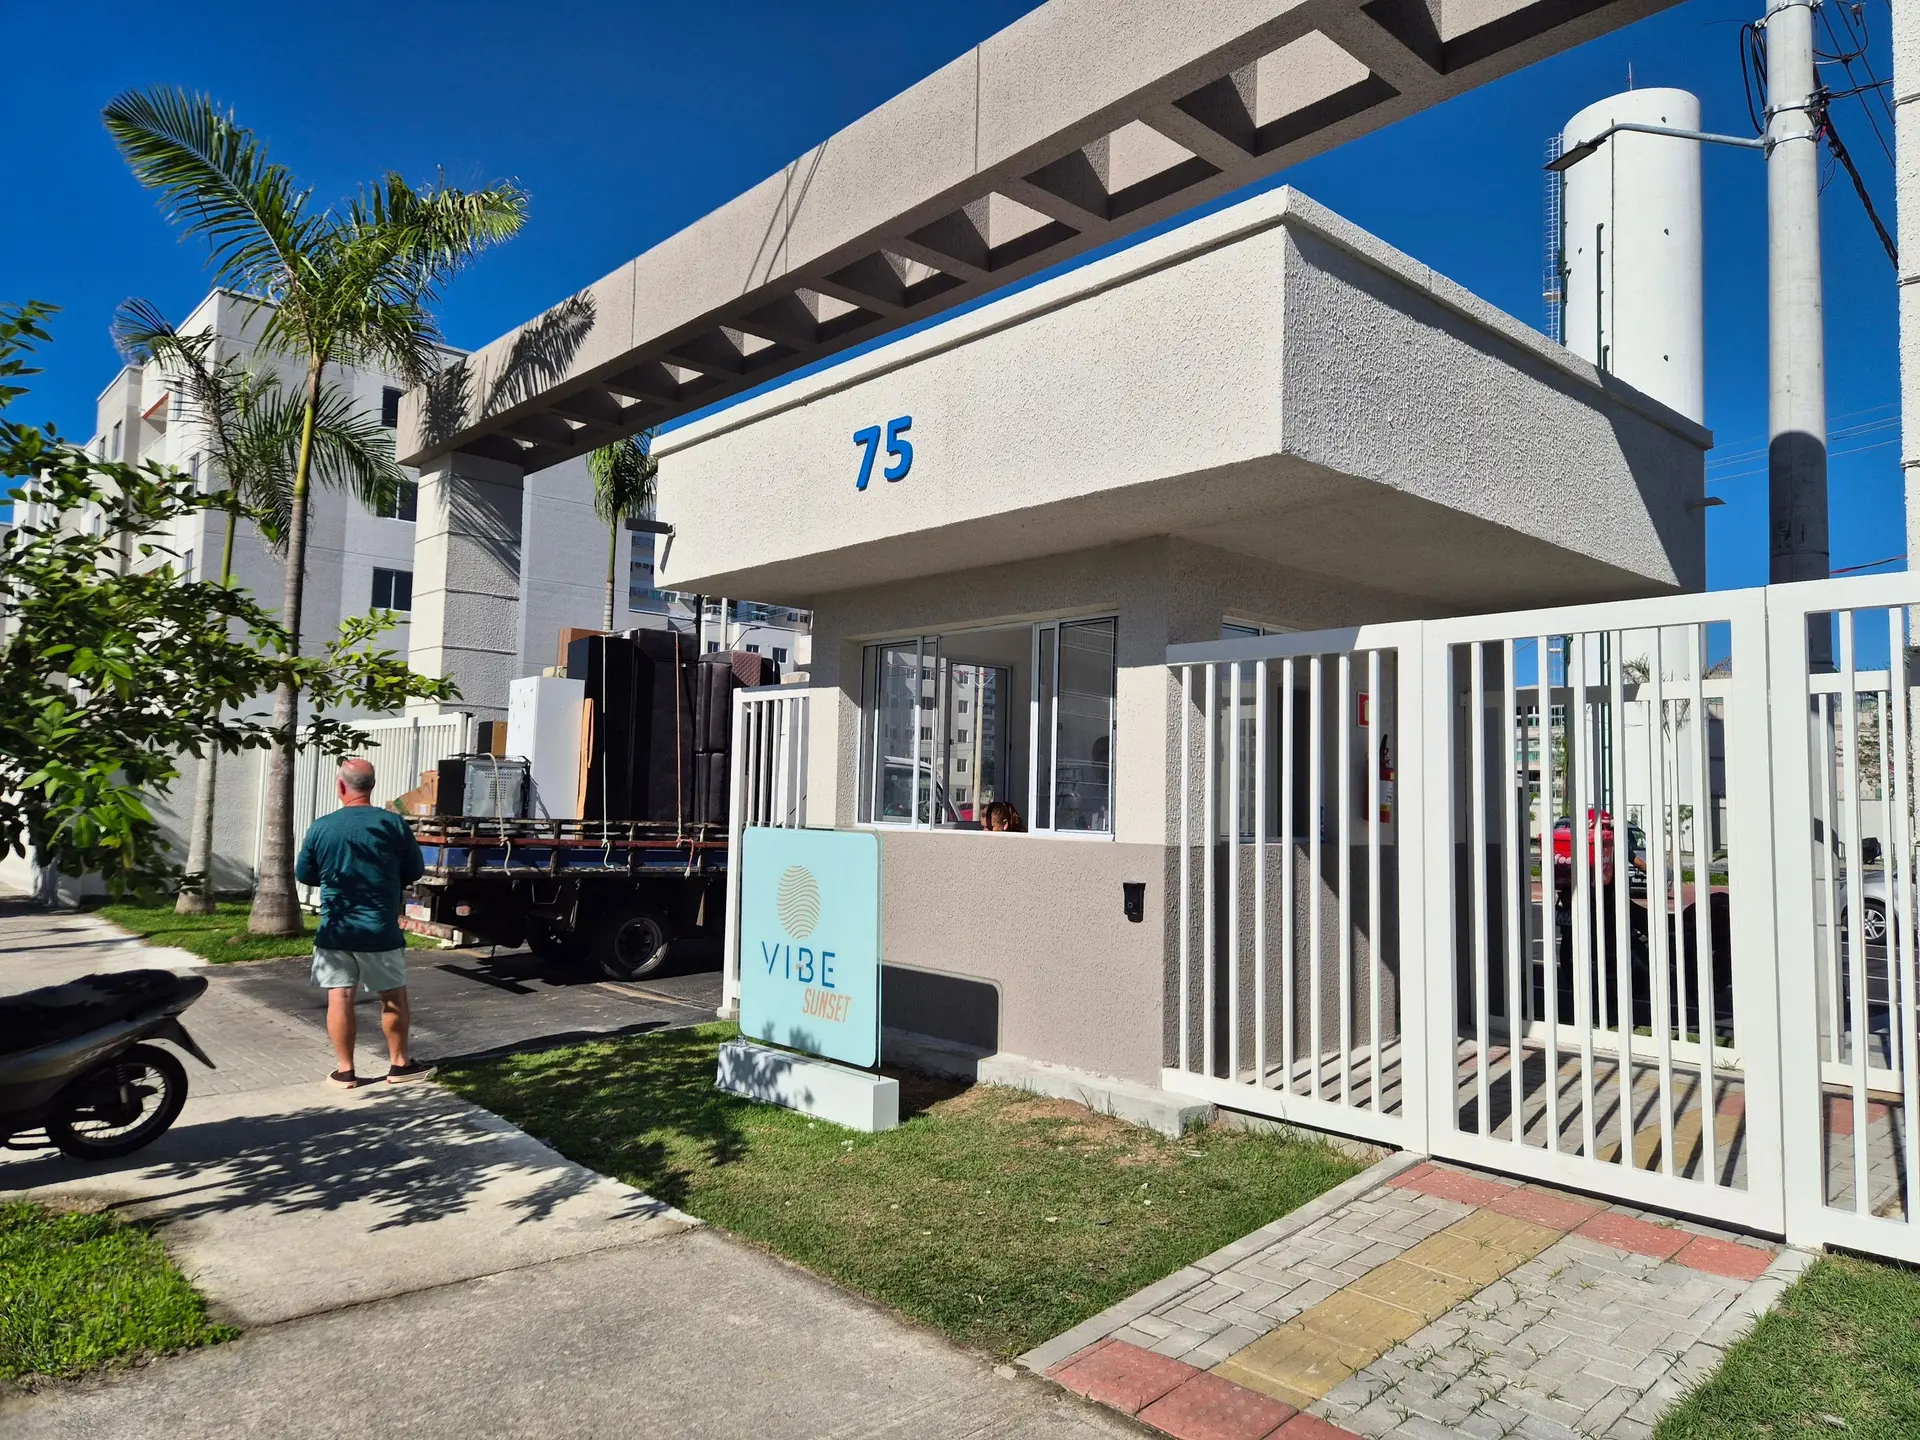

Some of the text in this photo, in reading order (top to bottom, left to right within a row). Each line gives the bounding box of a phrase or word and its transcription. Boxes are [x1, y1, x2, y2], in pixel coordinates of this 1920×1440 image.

[852, 415, 914, 491] 75
[761, 941, 836, 988] VIBE
[802, 987, 852, 1023] SUNSET
